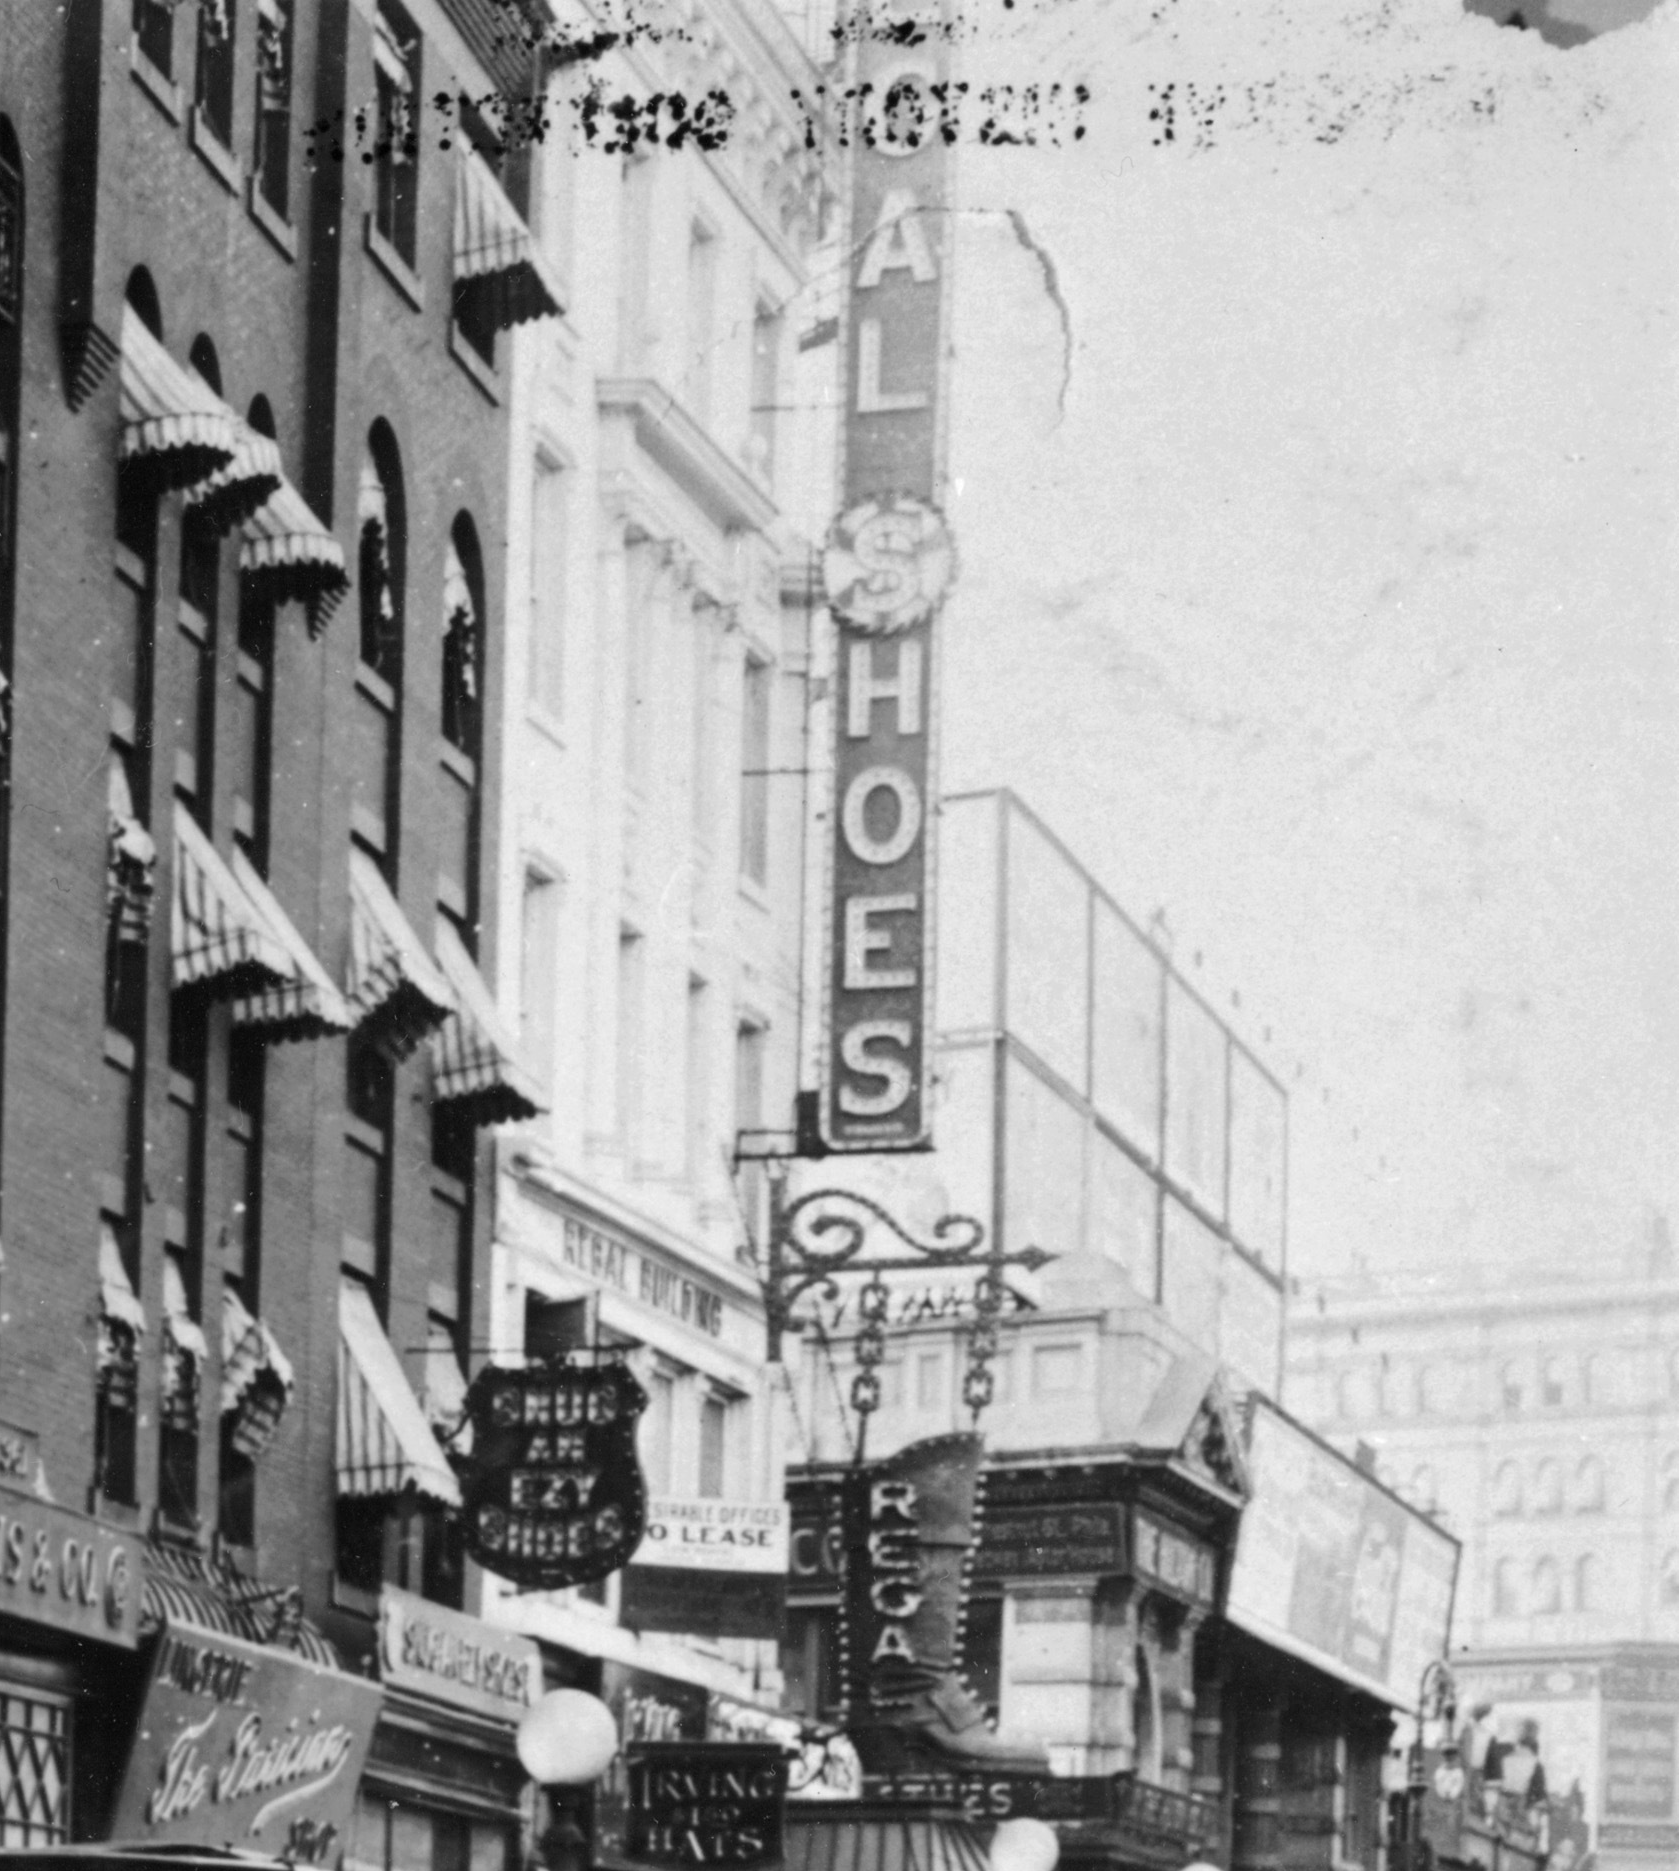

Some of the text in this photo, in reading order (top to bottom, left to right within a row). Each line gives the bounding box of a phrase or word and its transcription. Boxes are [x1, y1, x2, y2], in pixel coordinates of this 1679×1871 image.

[849, 28, 944, 416] GAL
[839, 510, 926, 1117] SHOES
[29, 1529, 52, 1594] &
[477, 1502, 624, 1561] SHOES
[646, 1523, 773, 1548] O LEASE
[647, 1825, 765, 1864] HATS
